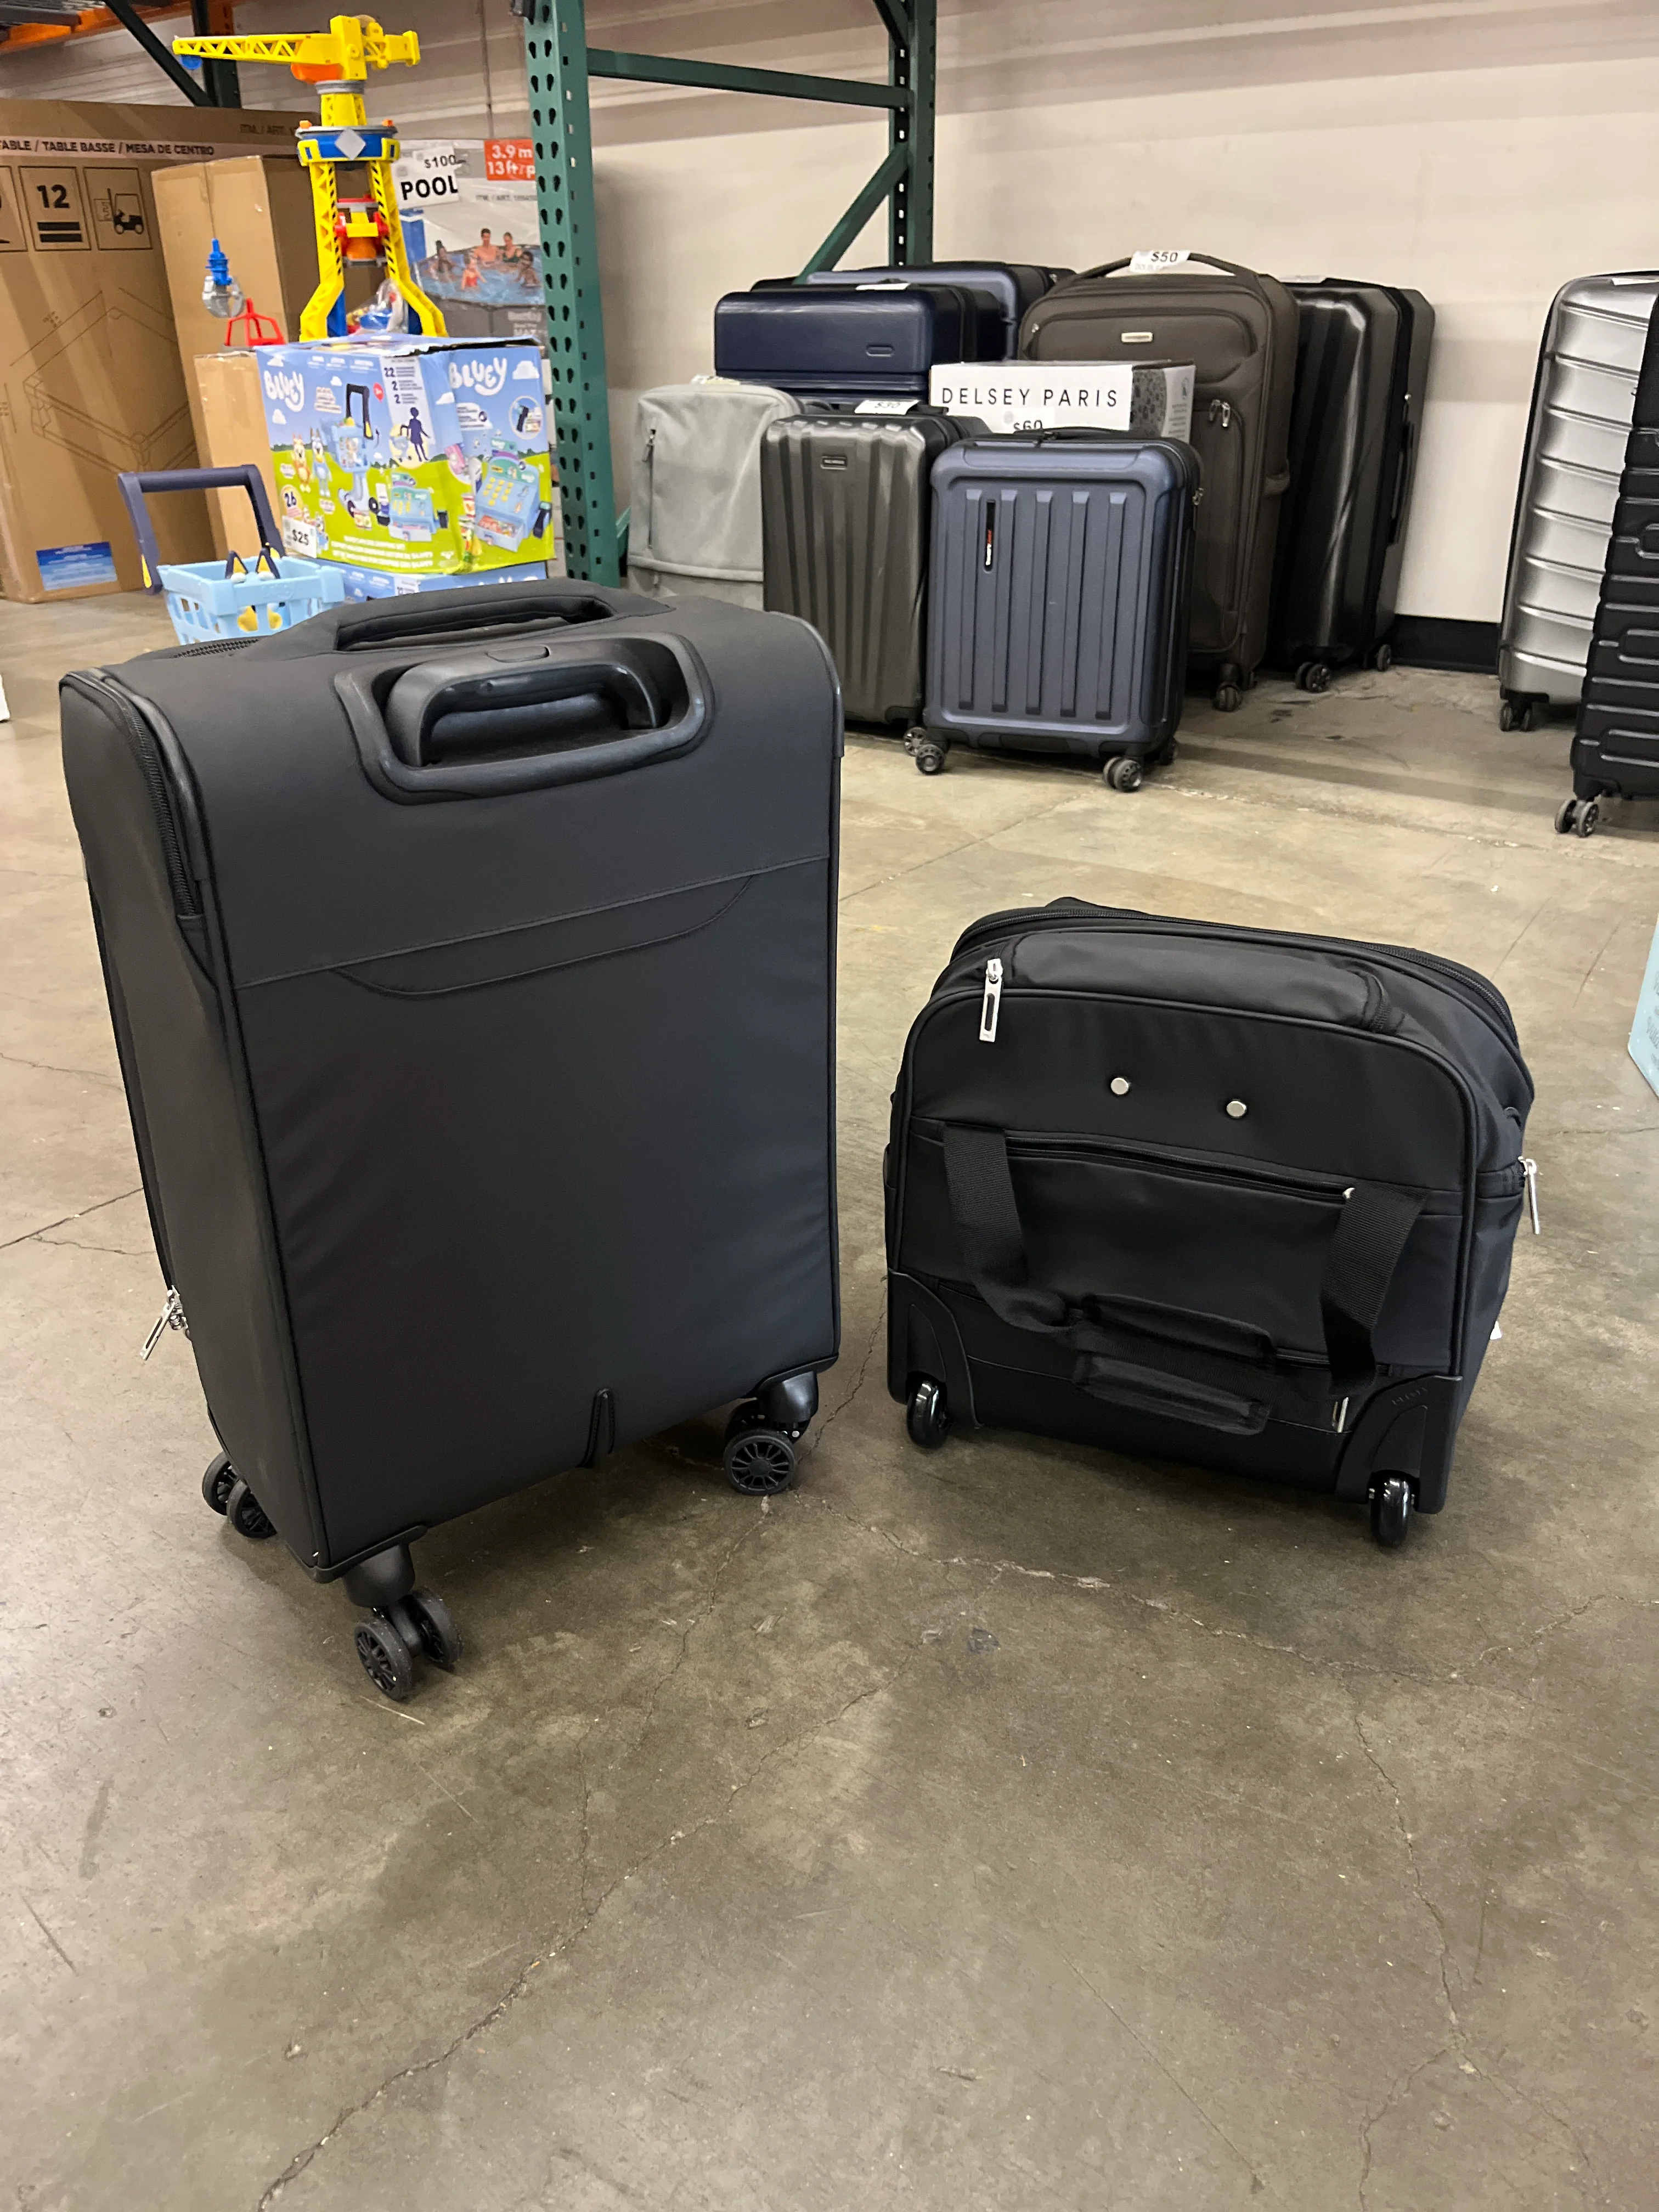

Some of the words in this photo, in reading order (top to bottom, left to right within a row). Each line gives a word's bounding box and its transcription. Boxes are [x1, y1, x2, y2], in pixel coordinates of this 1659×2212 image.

[42, 141, 77, 151] TABLE
[80, 142, 115, 153] BASSE
[125, 143, 155, 154] MESA
[157, 144, 172, 154] DE
[174, 145, 215, 156] CENTRO
[492, 144, 516, 159] 3.9
[424, 154, 456, 168] $100
[400, 175, 459, 201] POOL
[36, 184, 70, 208] 12
[1151, 251, 1178, 262] $50
[942, 387, 1030, 405] DELSEY
[1043, 389, 1117, 407] PARIS
